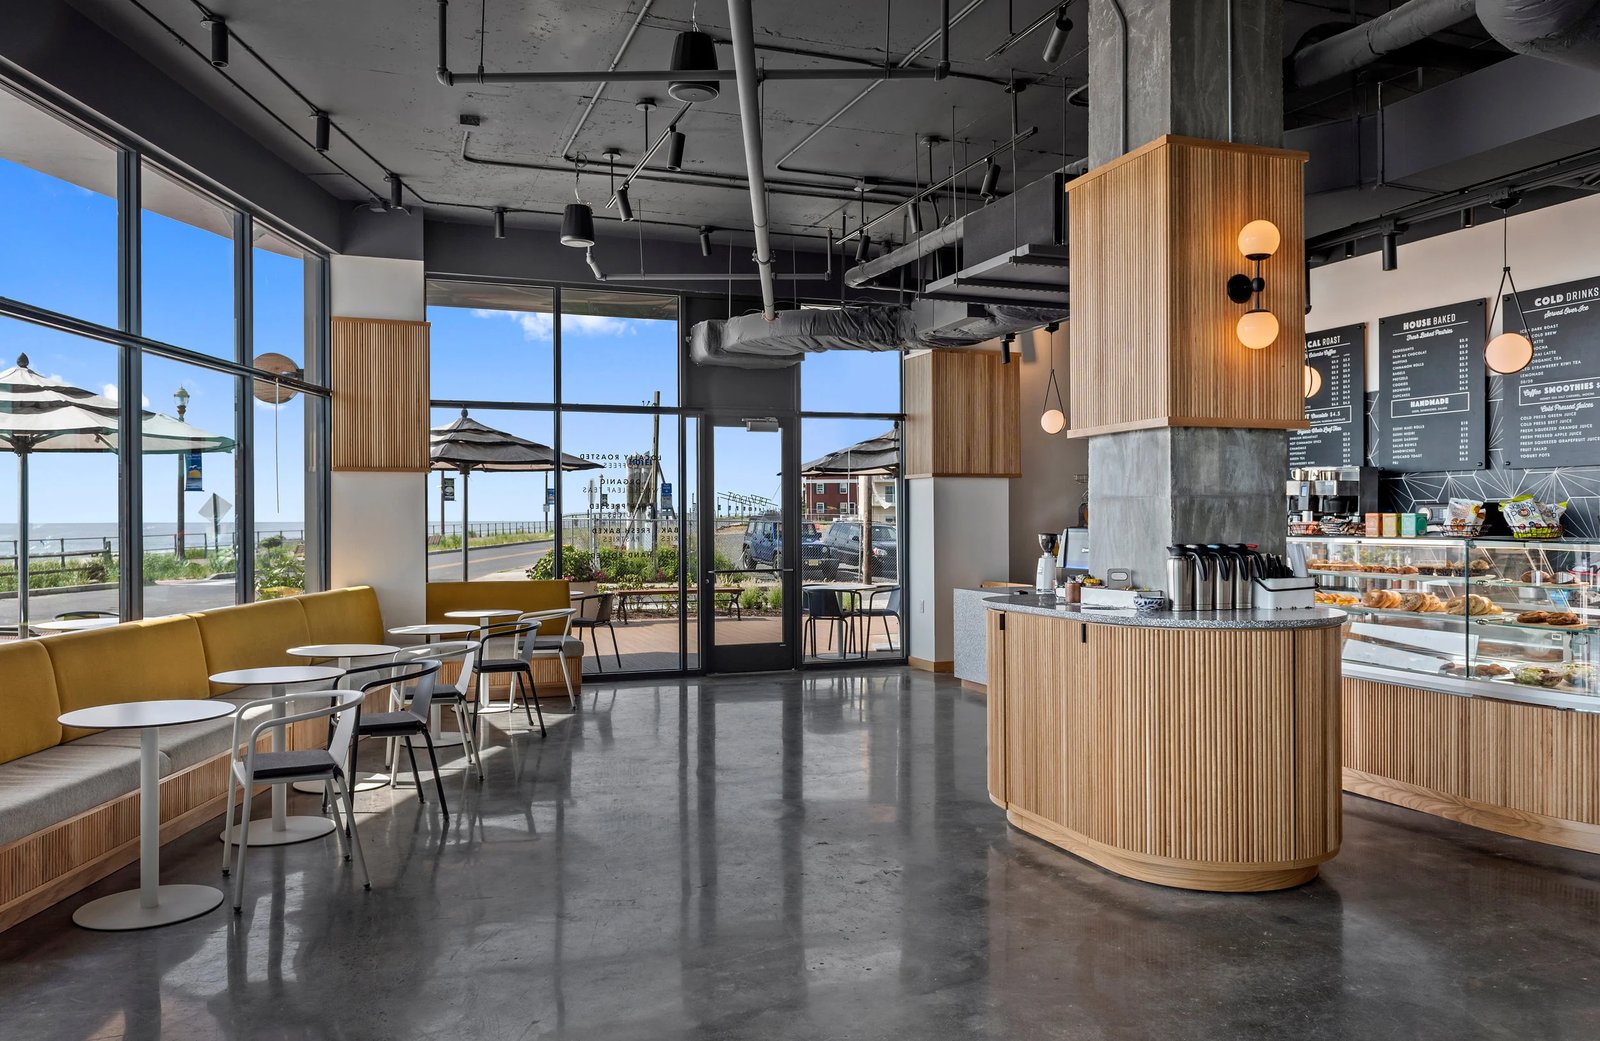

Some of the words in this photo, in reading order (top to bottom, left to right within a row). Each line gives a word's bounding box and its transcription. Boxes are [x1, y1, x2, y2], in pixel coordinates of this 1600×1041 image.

[1534, 294, 1564, 307] COLD
[1566, 287, 1600, 302] DRINKS
[1544, 308, 1563, 319] Served
[1563, 307, 1577, 315] Over
[1577, 304, 1589, 313] Ice
[1403, 318, 1431, 330] HOUSE
[1433, 313, 1456, 325] BAKED
[1322, 335, 1341, 346] ROAST
[1523, 388, 1541, 397] Coffee
[1544, 381, 1594, 394] SMOOTHIES
[1410, 397, 1449, 408] HANDMADE
[1540, 404, 1554, 413] Cold
[1554, 403, 1575, 411] Pressed
[1575, 401, 1594, 411] Juices
